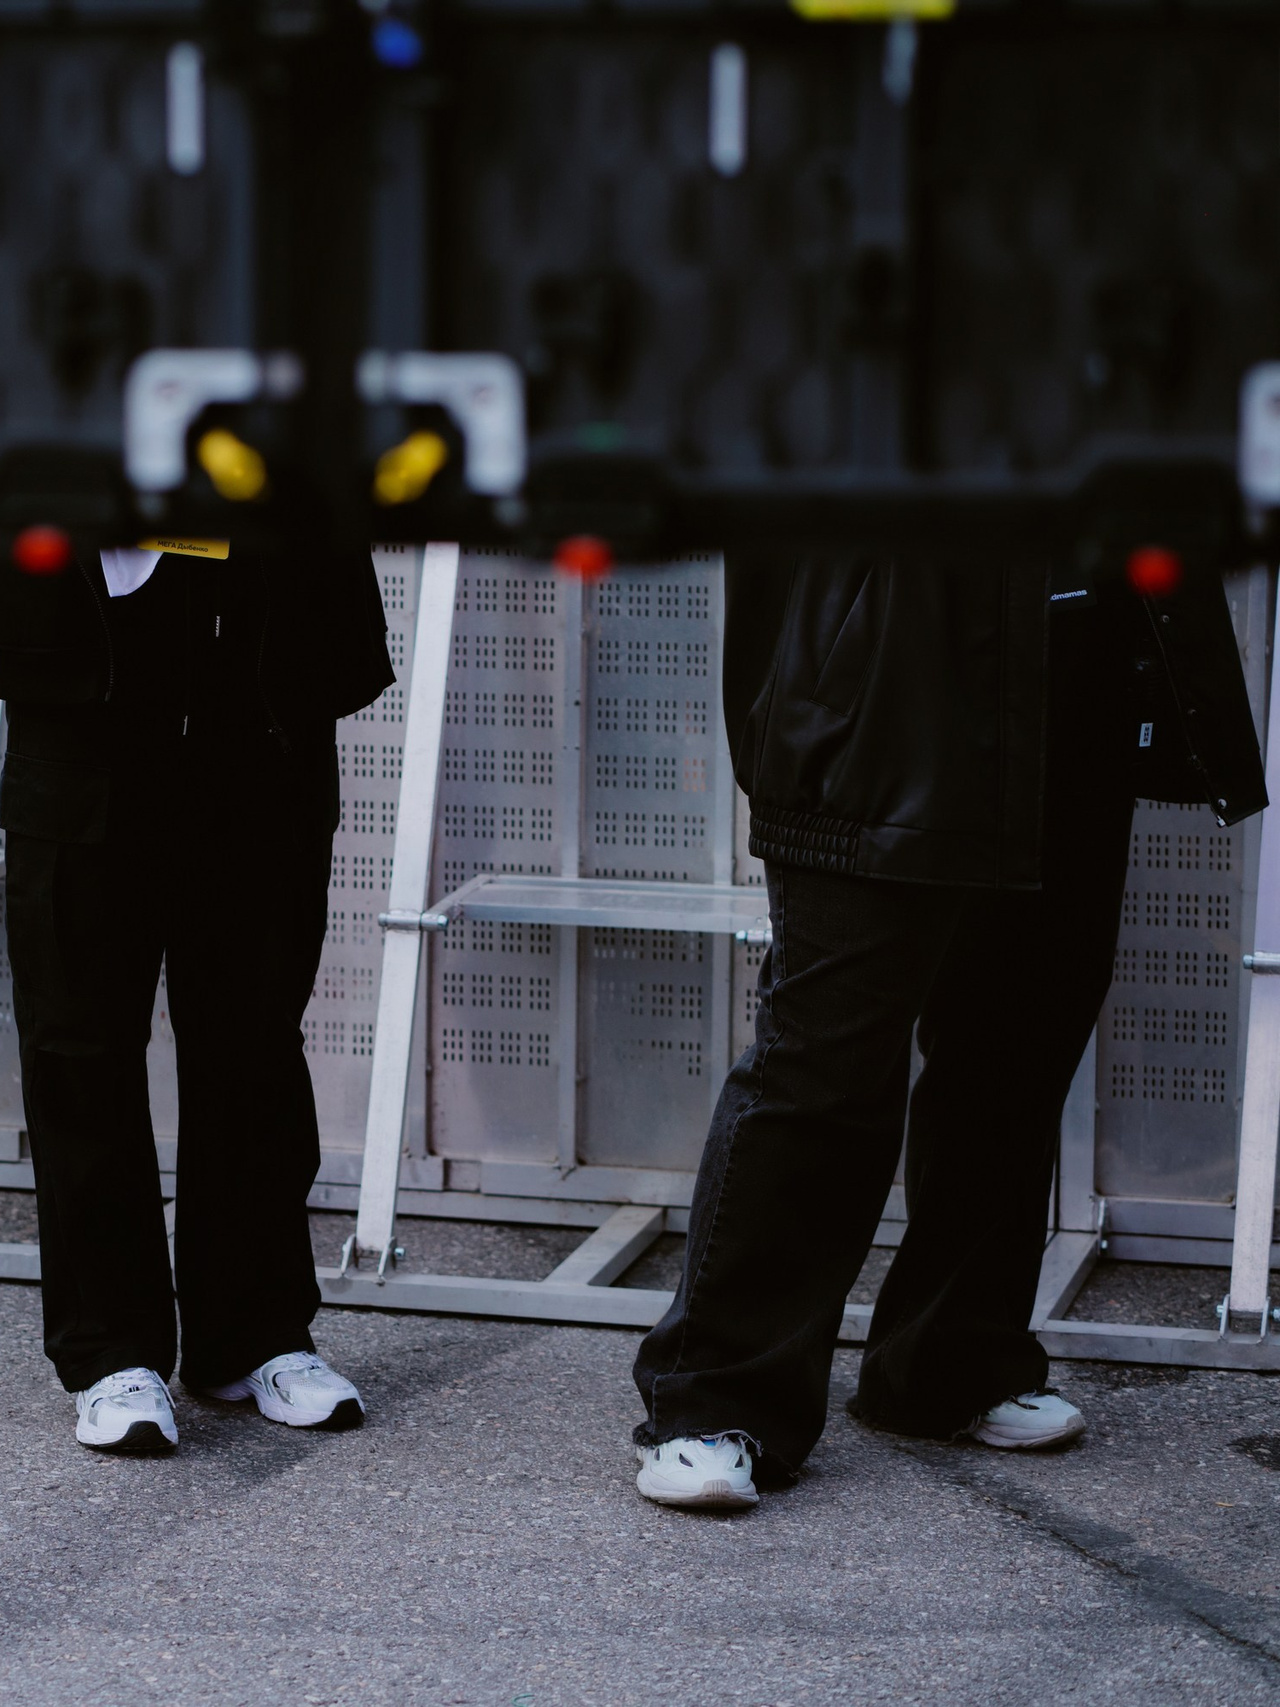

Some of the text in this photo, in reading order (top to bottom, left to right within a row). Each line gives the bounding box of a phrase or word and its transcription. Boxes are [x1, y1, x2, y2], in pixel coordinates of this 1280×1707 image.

[157, 540, 209, 553] МЕГА Дыбенко
[1050, 589, 1088, 601] dmamas
